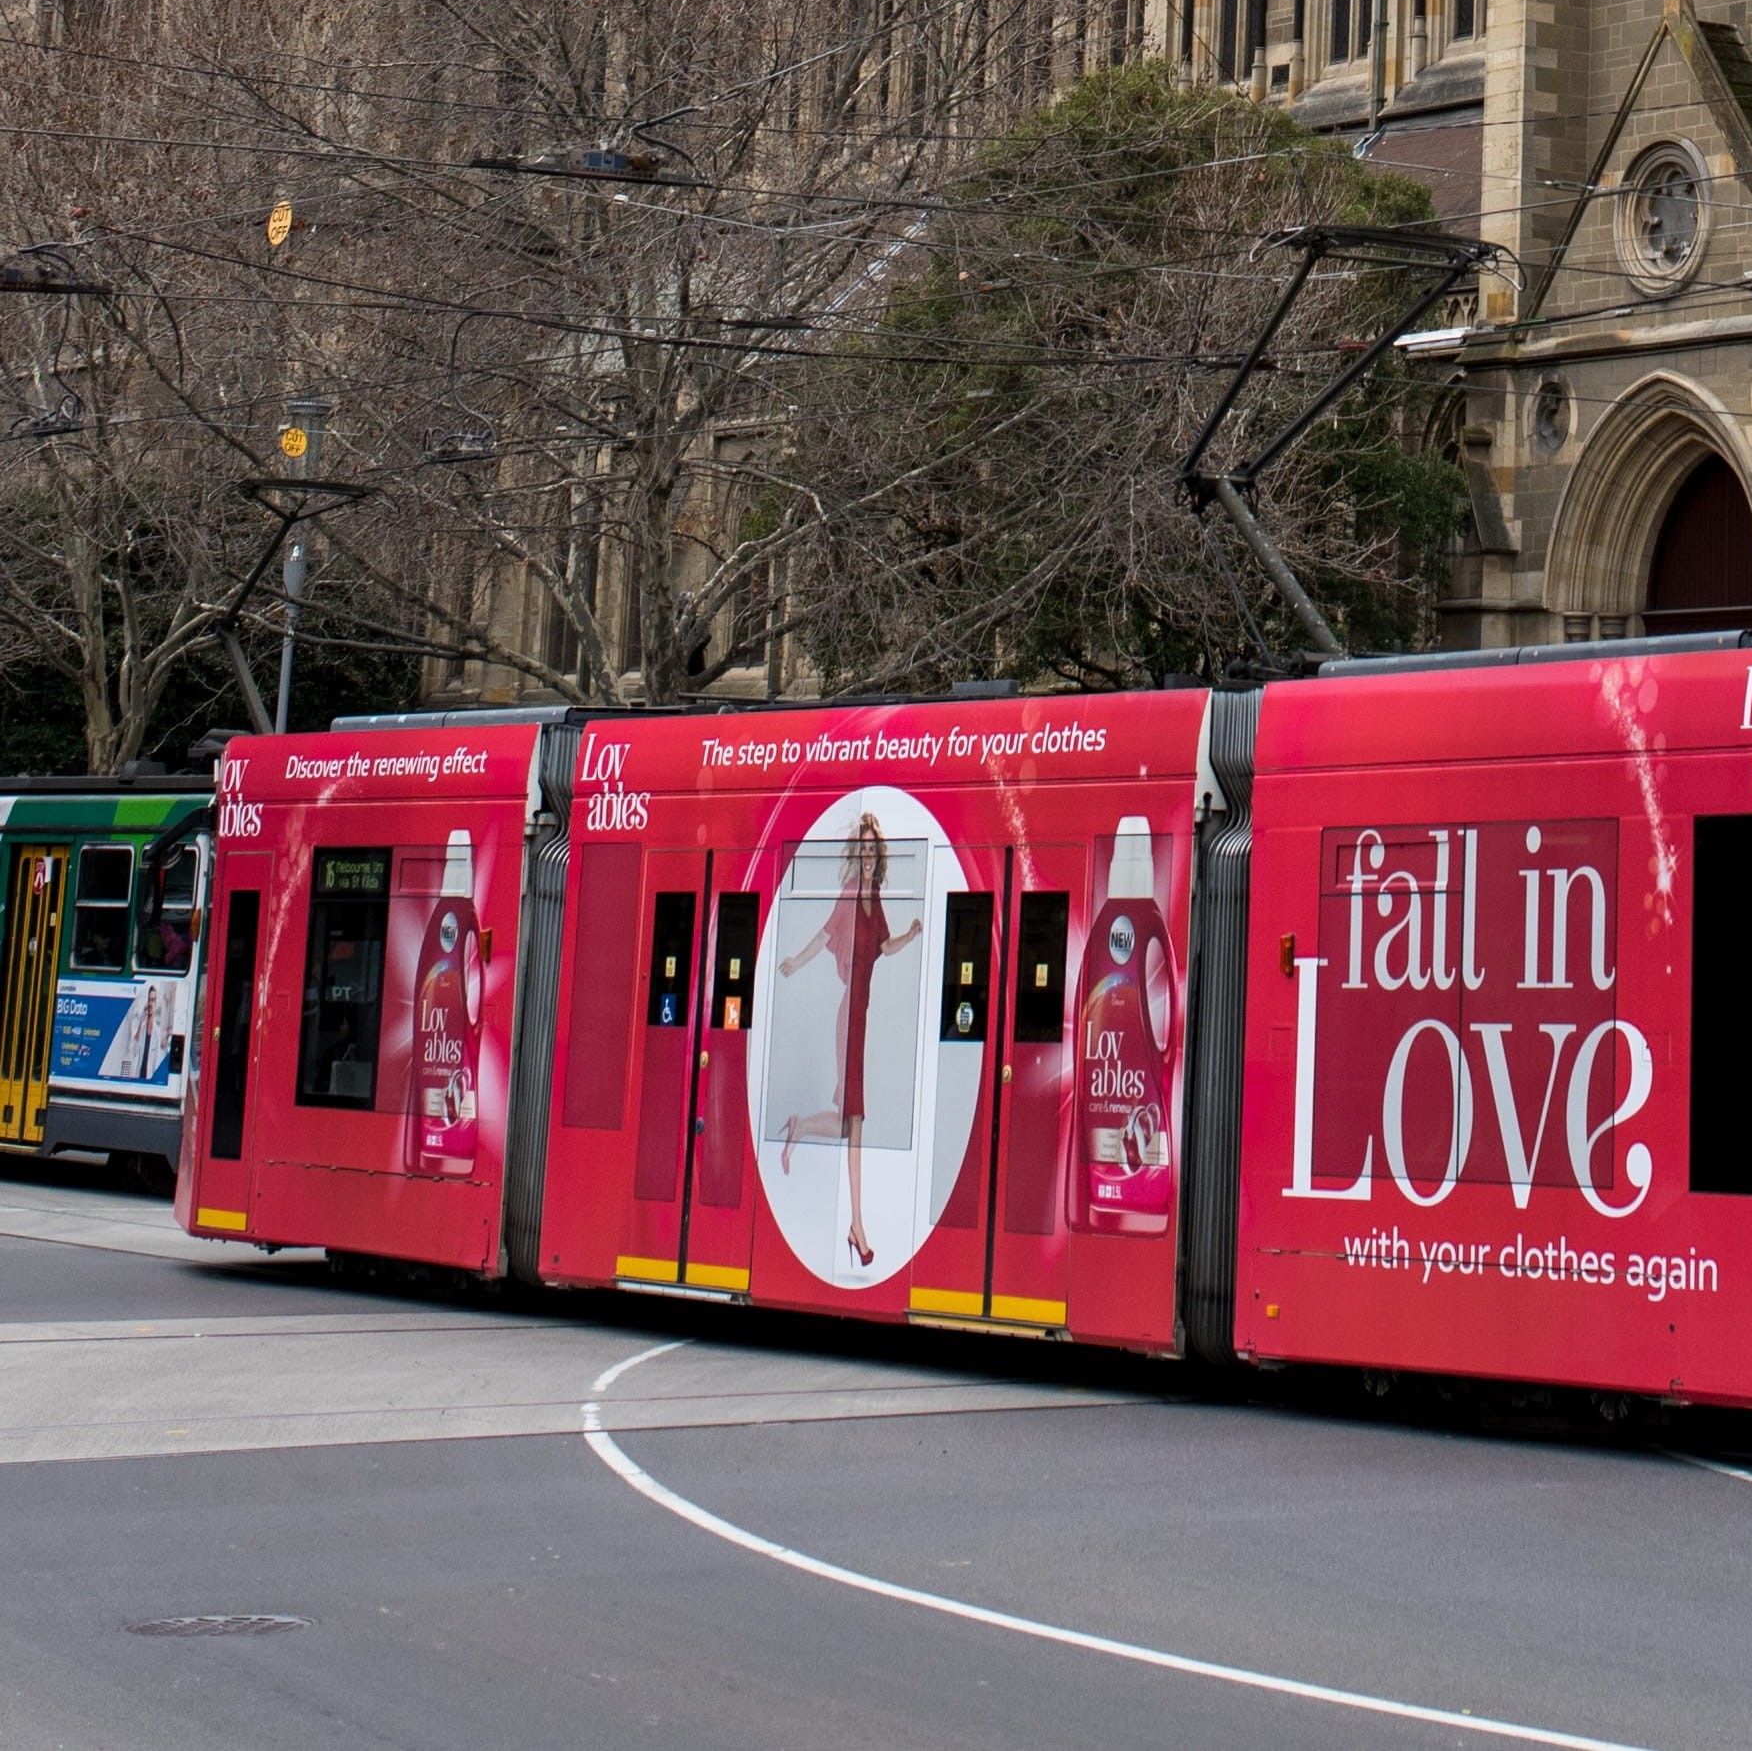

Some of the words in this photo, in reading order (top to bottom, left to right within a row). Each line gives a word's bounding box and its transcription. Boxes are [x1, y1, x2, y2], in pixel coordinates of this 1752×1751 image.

[270, 225, 288, 240] OFF
[272, 208, 290, 223] CUT
[285, 754, 345, 779] Discover
[346, 751, 369, 777] the
[372, 751, 439, 782] renewing
[442, 746, 488, 774] effect
[580, 732, 631, 782] Lov
[701, 738, 733, 766] The
[736, 738, 777, 771] step
[781, 739, 801, 763] to
[805, 735, 871, 762] vibrant
[874, 730, 943, 766] beauty
[947, 726, 978, 757] for
[980, 732, 1027, 764] your
[1031, 721, 1107, 754] clothes
[586, 781, 651, 832] ables
[1341, 829, 1485, 991] fall
[1515, 825, 1616, 991] in
[1110, 931, 1133, 948] NEW
[421, 999, 449, 1032] Lov
[424, 1032, 462, 1063] ables
[1085, 1020, 1125, 1061] Lov
[1090, 1060, 1145, 1098] ables
[1281, 957, 1654, 1218] Love
[1344, 1226, 1409, 1270] with
[1419, 1236, 1491, 1284] your
[1499, 1234, 1616, 1285] clothes
[1626, 1247, 1719, 1302] again
